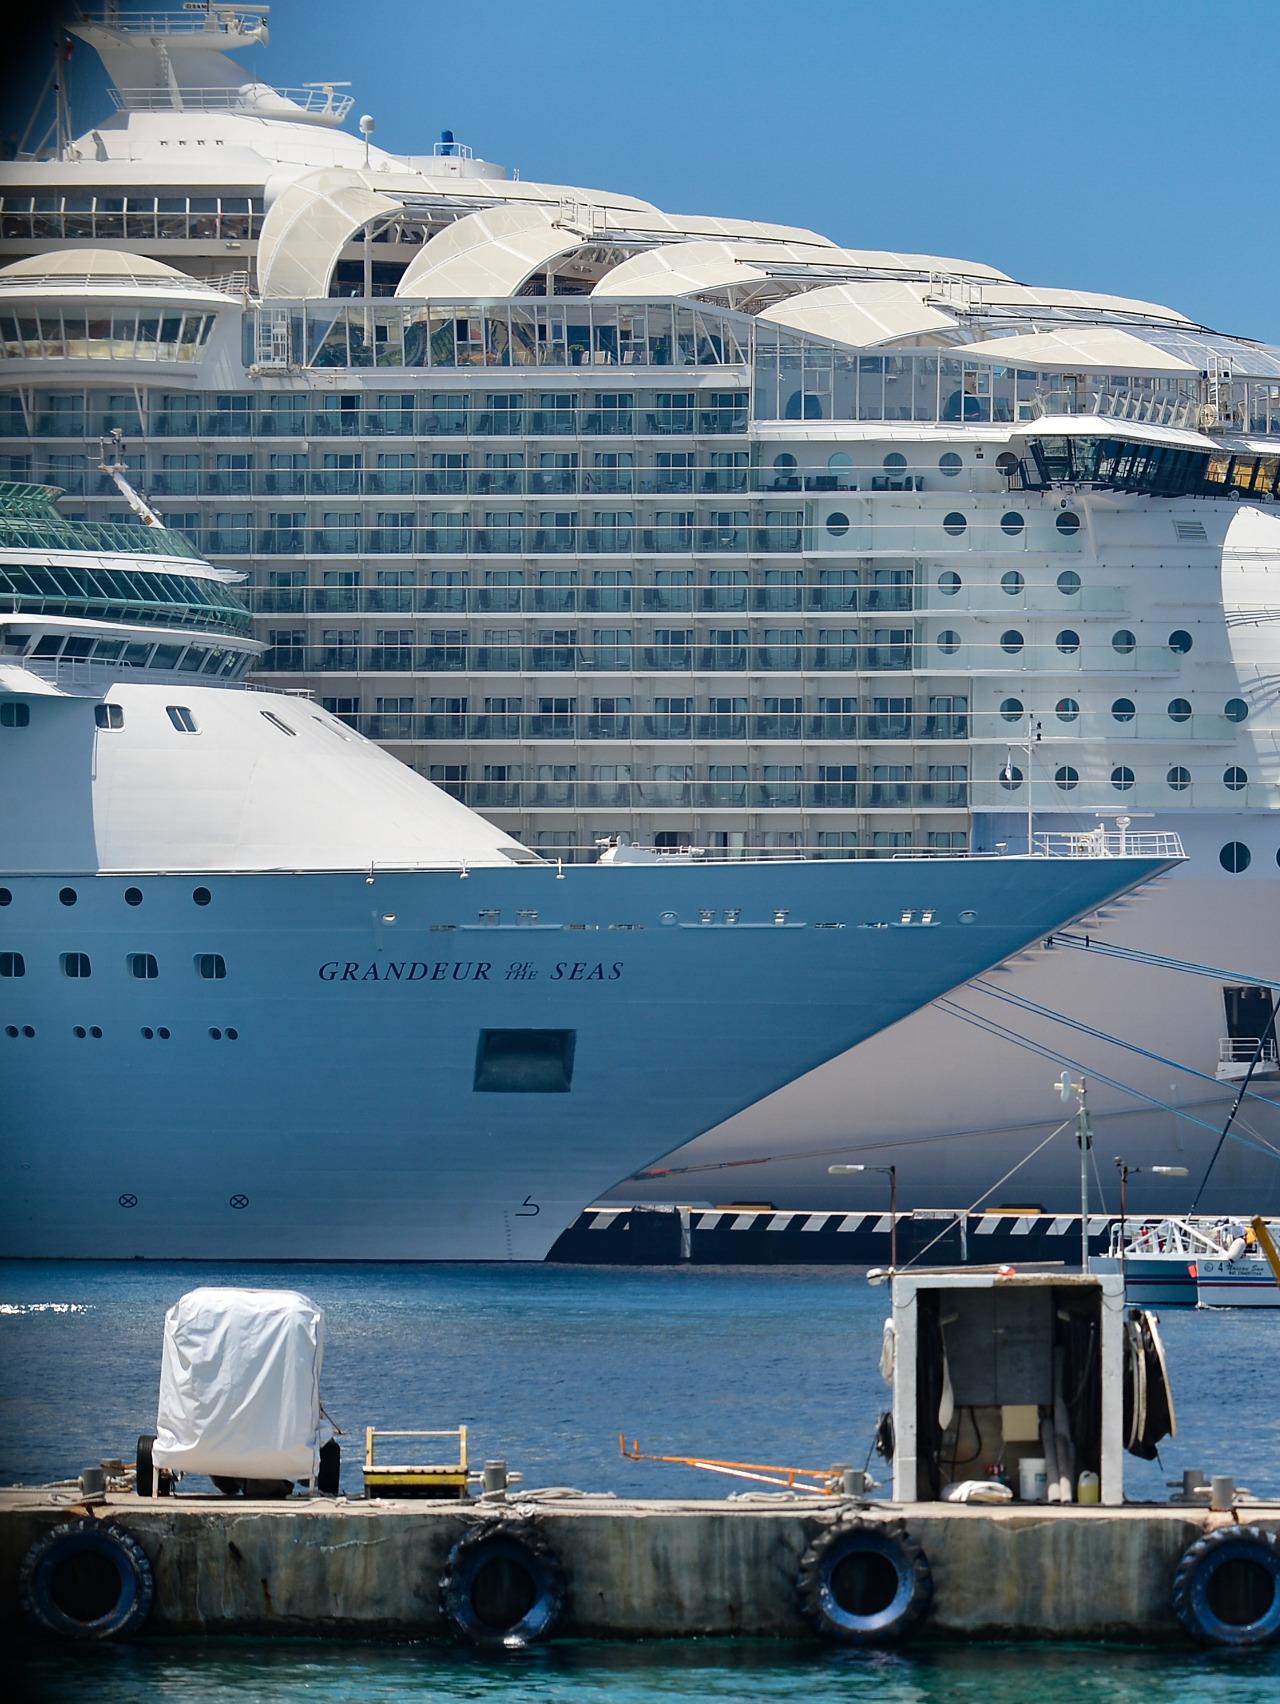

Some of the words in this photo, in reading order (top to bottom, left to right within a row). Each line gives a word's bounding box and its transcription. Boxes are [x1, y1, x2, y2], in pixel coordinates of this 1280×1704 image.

[318, 961, 492, 981] GRANDEUR
[509, 961, 532, 971] OF
[550, 961, 624, 981] SEAS
[504, 970, 539, 981] THE
